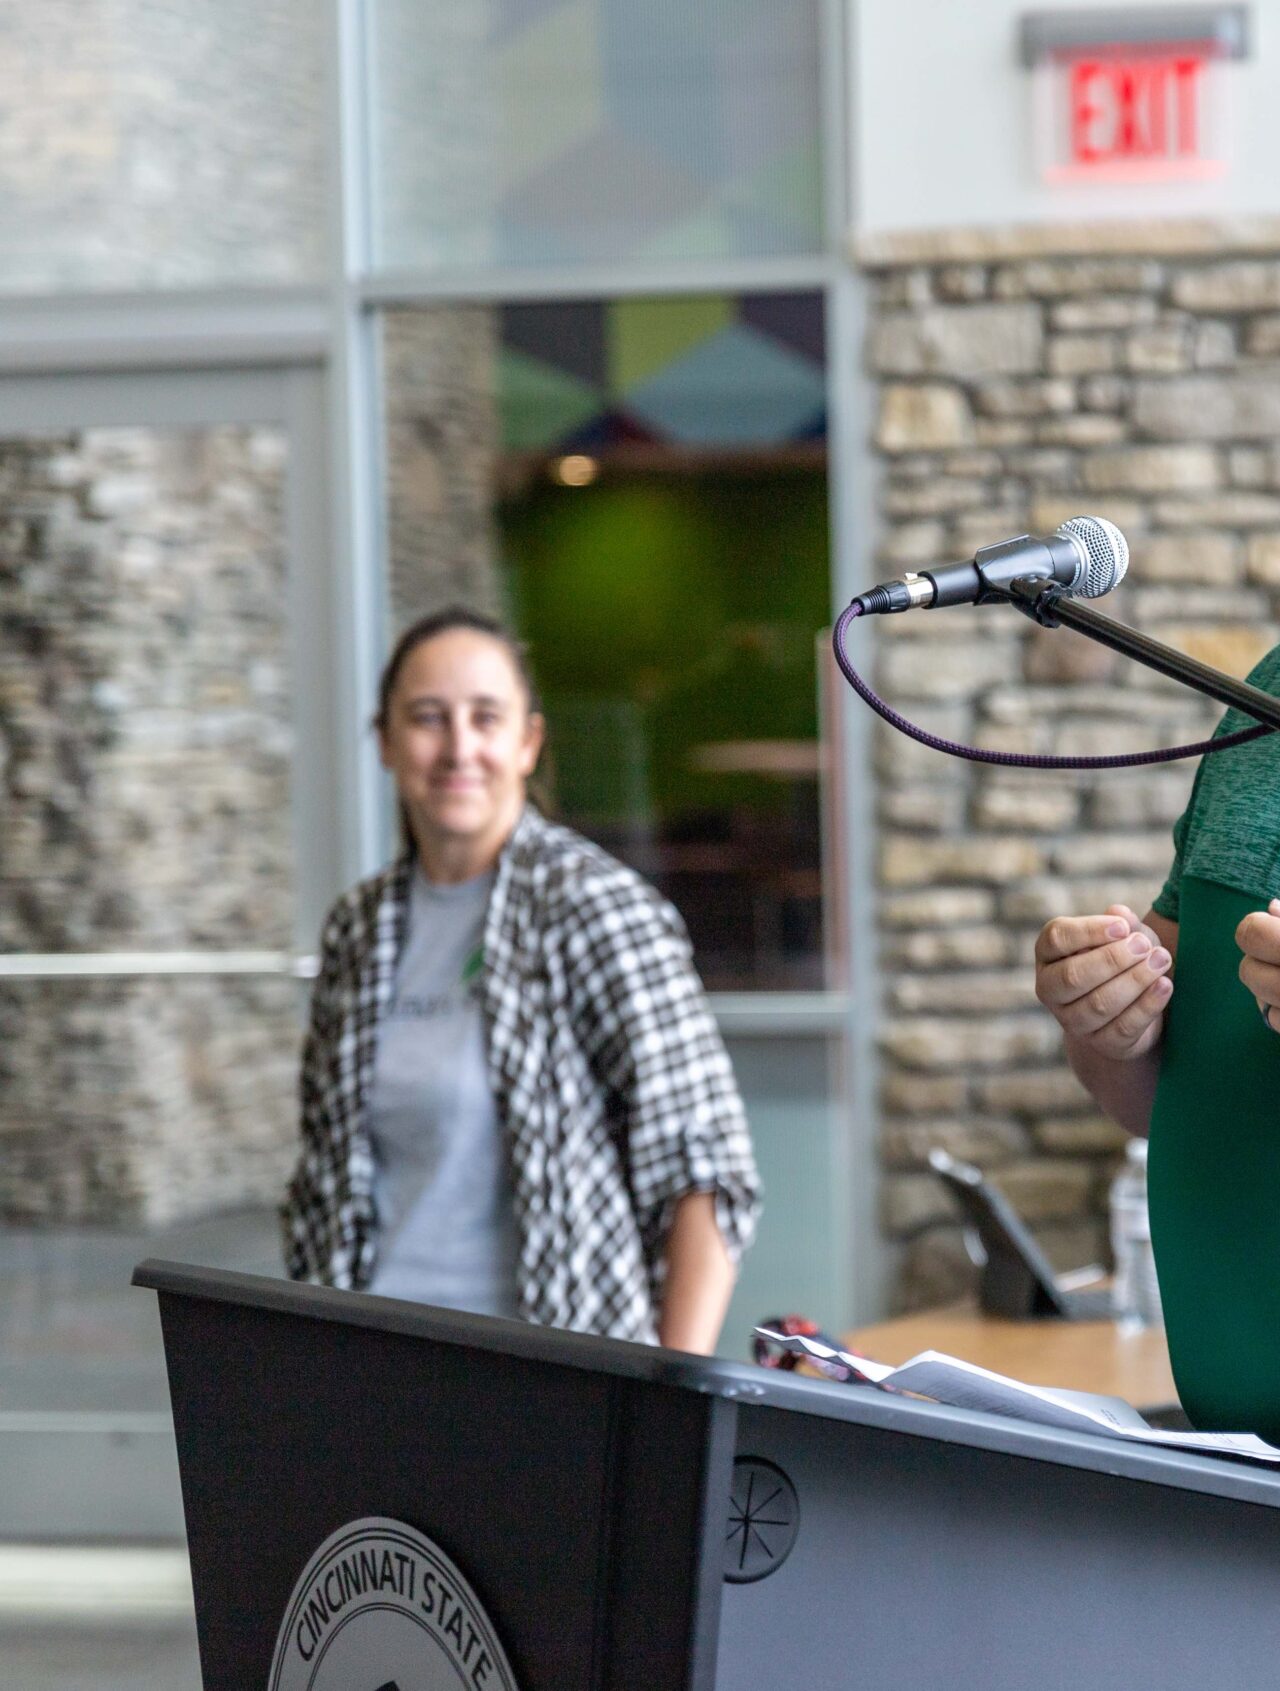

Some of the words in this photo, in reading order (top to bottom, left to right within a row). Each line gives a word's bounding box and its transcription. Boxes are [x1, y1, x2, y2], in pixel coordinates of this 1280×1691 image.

[1070, 58, 1204, 162] EXIT
[296, 1549, 416, 1662] CINCINNATI
[421, 1572, 492, 1691] STATE
